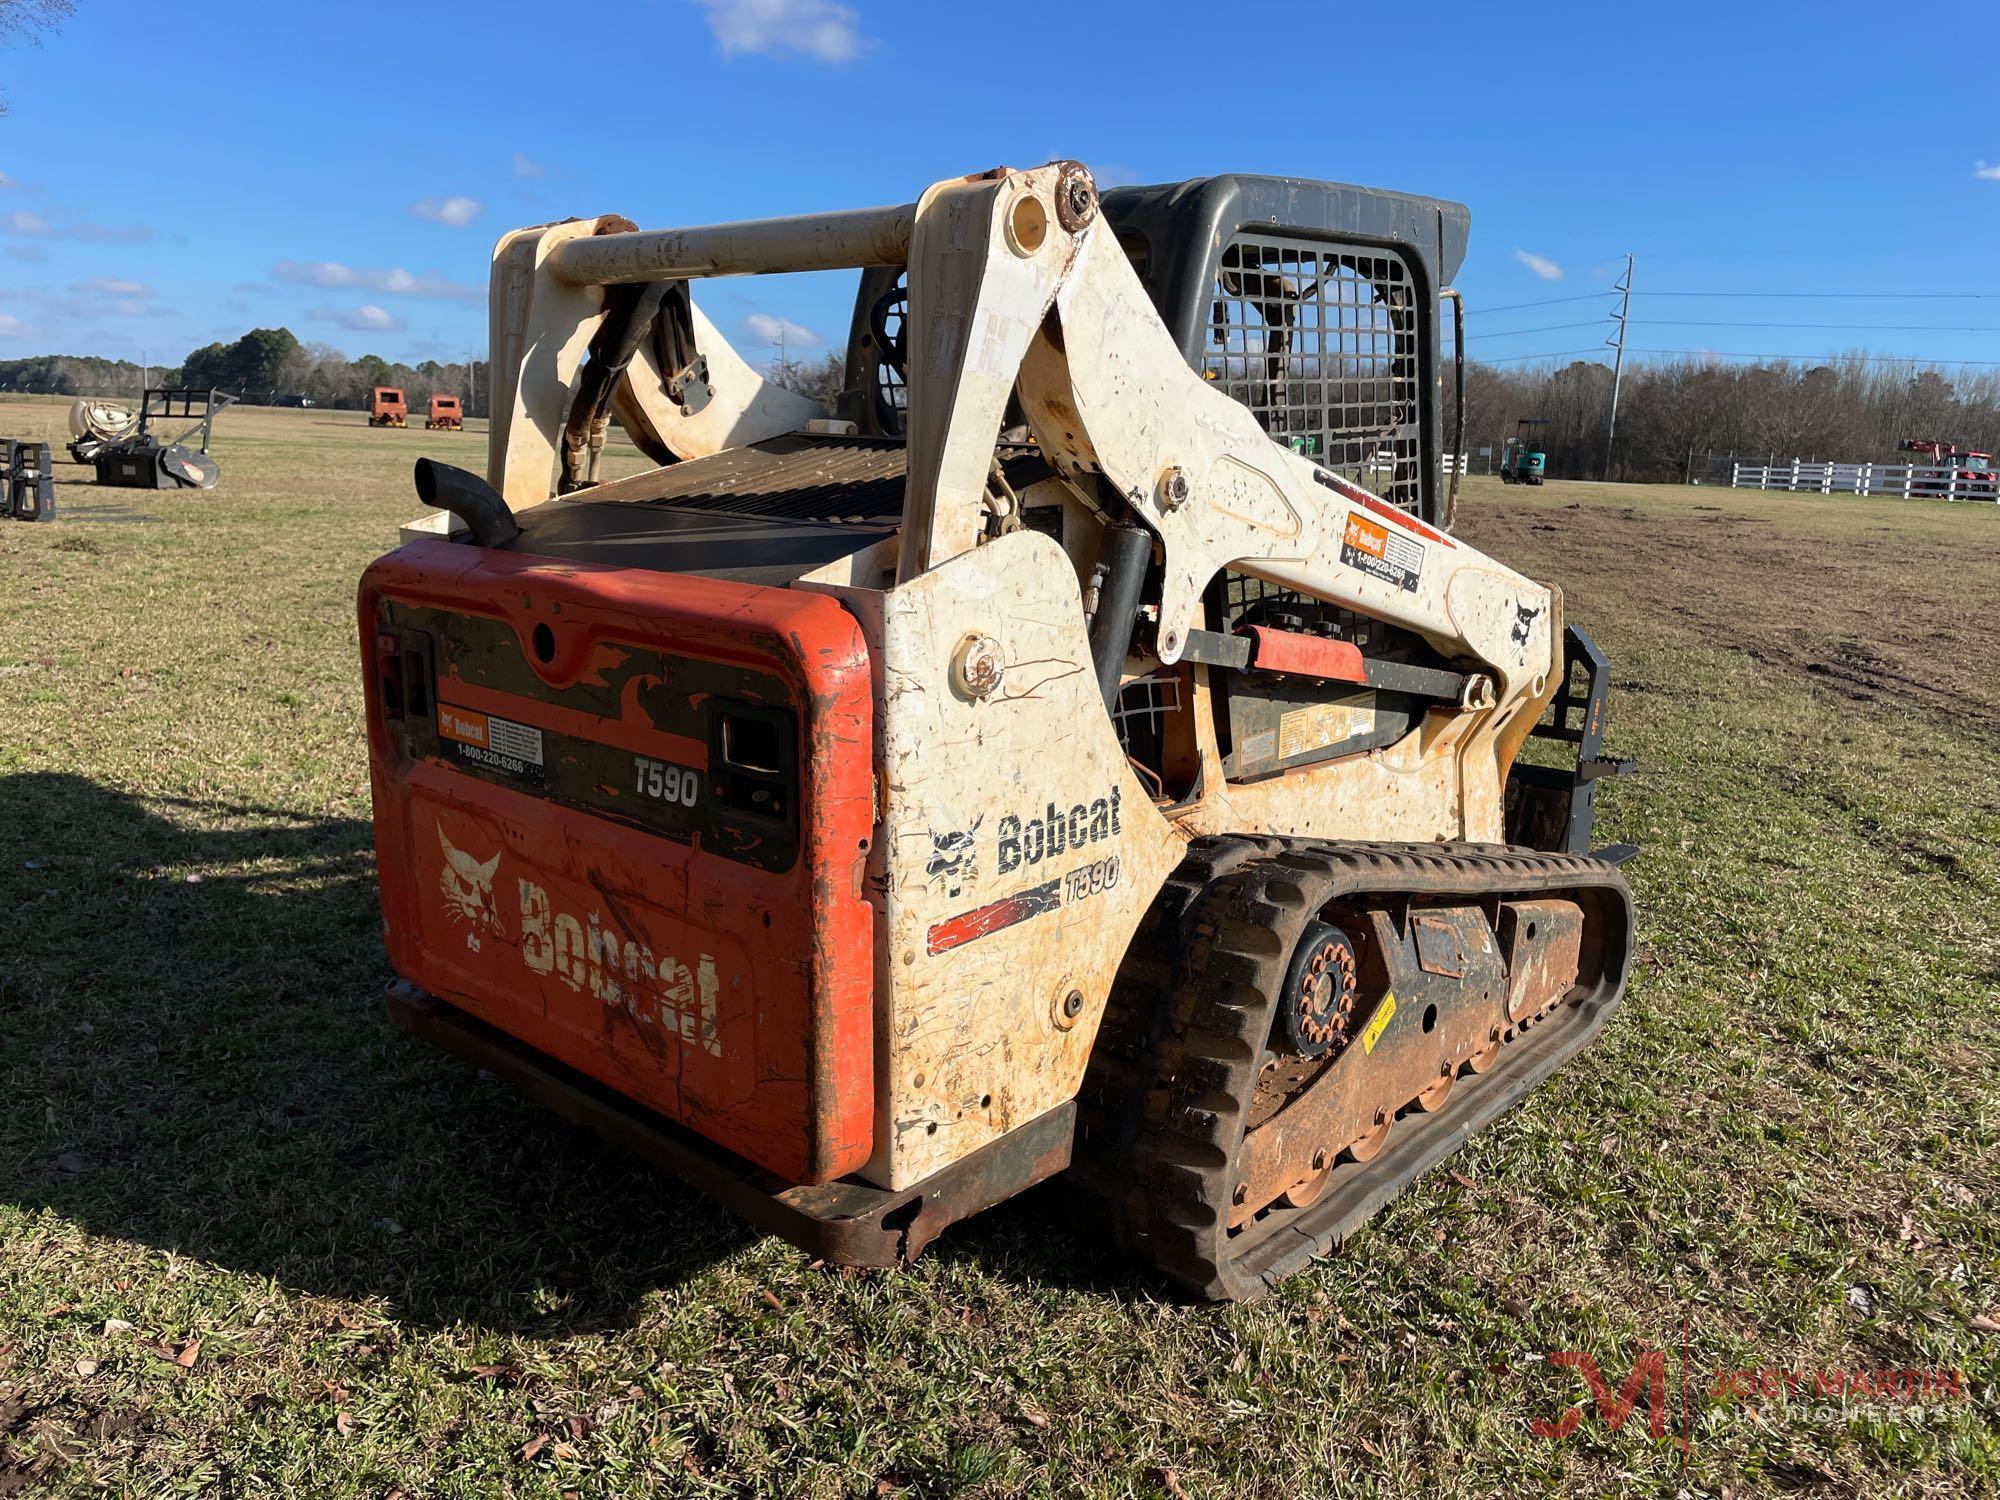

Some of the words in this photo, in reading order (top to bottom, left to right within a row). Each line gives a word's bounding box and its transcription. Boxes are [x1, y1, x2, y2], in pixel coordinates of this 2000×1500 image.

[454, 718, 483, 741] Bobcat
[457, 743, 524, 773] 1-800-220-6266
[634, 757, 699, 808] T590
[998, 785, 1121, 875] Bobcat
[1065, 856, 1120, 905] T590
